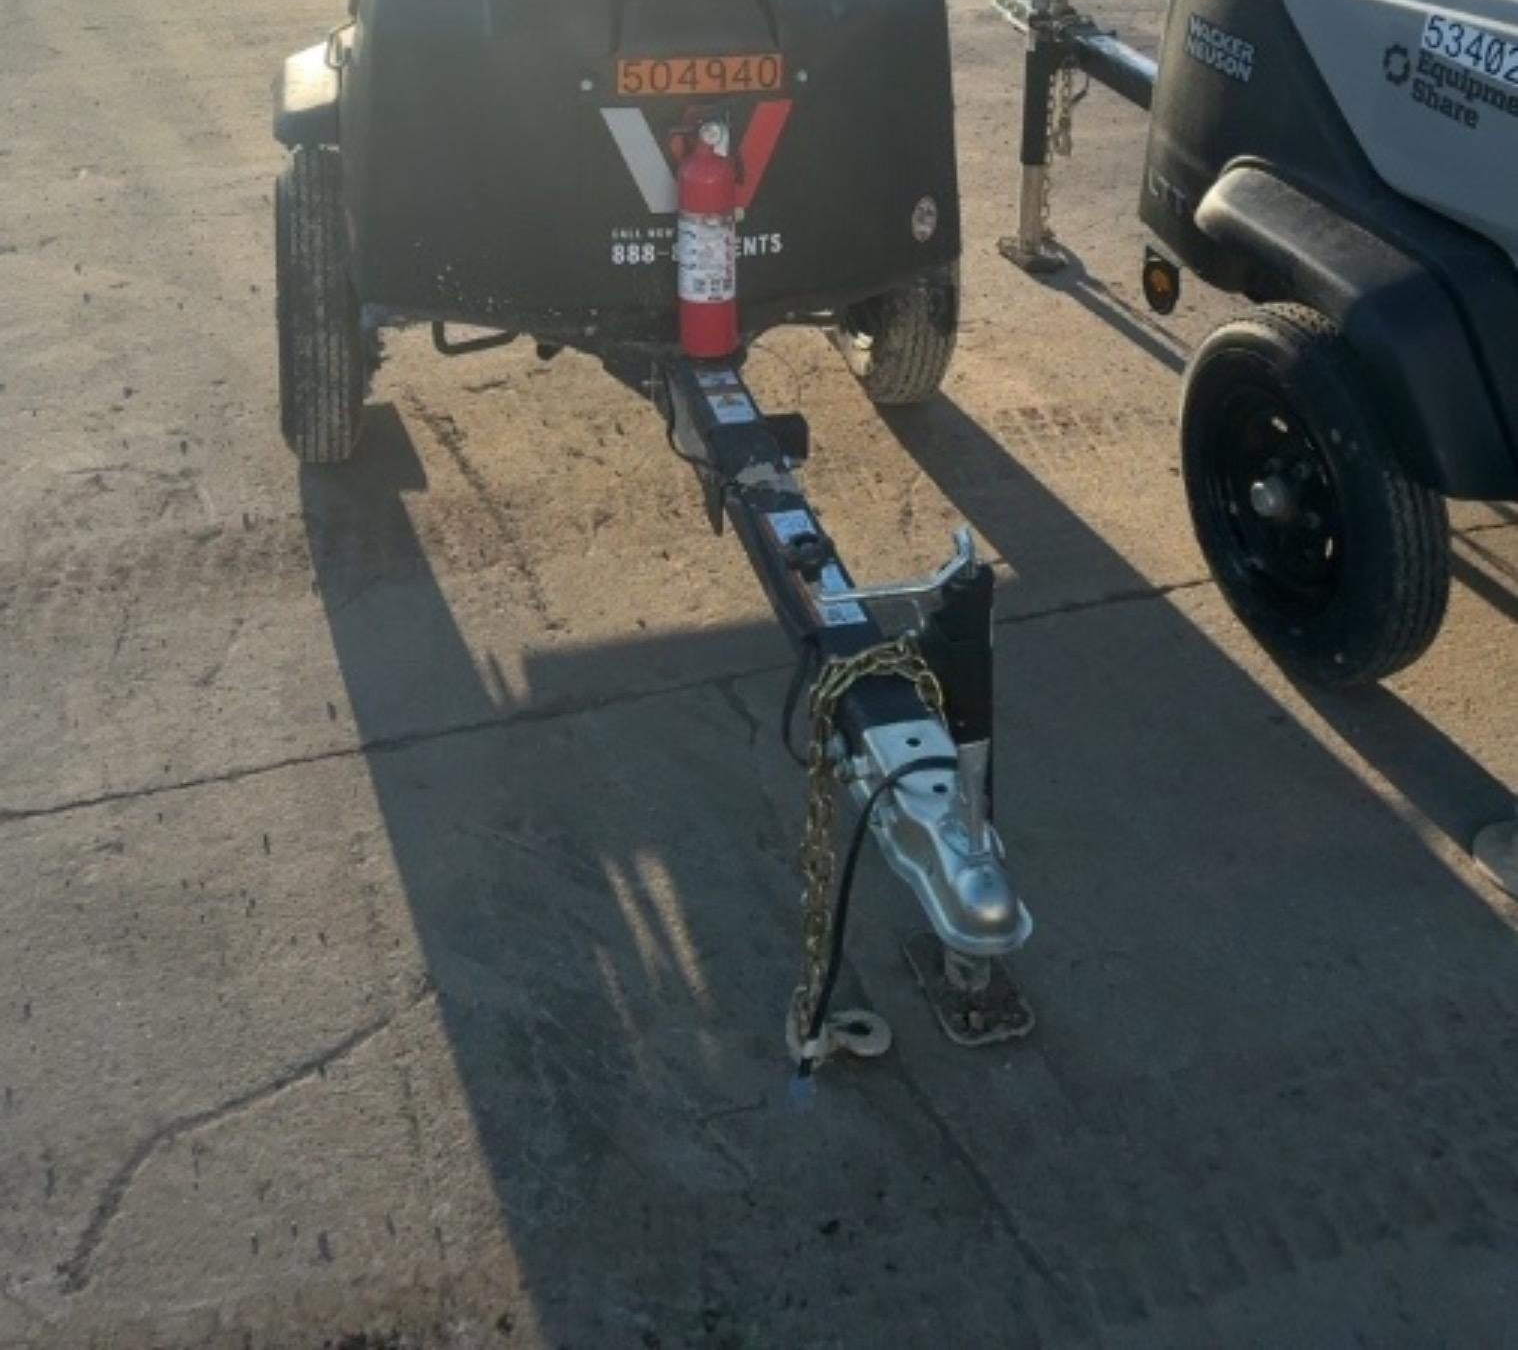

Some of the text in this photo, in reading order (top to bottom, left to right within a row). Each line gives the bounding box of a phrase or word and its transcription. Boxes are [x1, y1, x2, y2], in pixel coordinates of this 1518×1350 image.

[1185, 34, 1252, 83] NEUSON
[1189, 14, 1254, 63] WACKER
[1424, 14, 1518, 84] 53402
[622, 56, 779, 94] 504940
[1416, 48, 1518, 118] Equipme
[1411, 77, 1480, 130] Share
